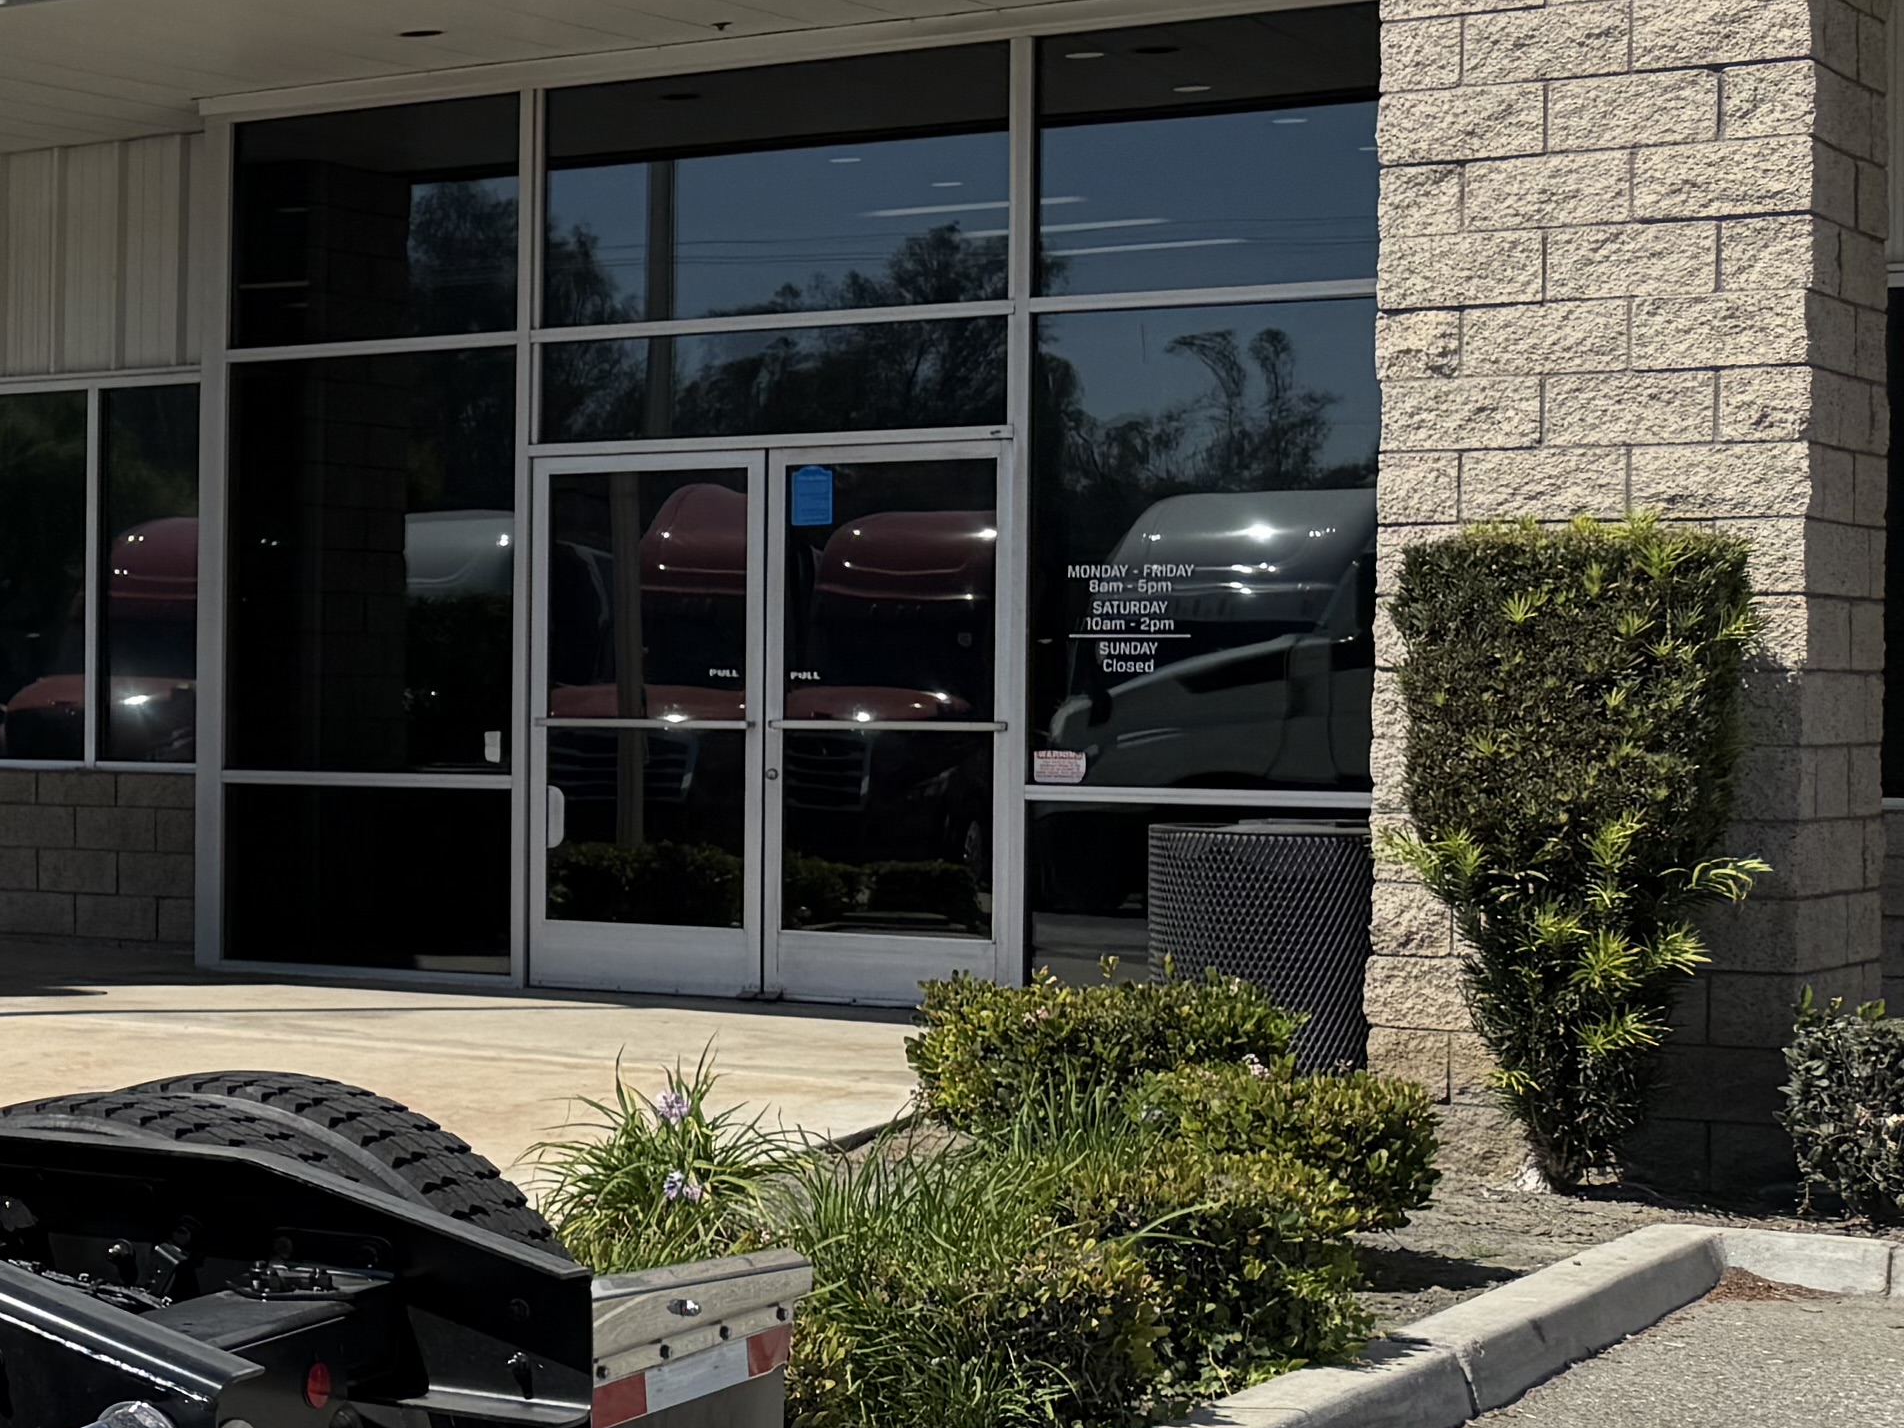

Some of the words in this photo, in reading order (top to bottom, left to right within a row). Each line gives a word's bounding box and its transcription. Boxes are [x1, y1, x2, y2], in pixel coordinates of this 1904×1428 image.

[1067, 565, 1129, 578] MONDAY
[1143, 564, 1195, 578] FRIDAY
[1089, 580, 1123, 593] 8am
[1137, 580, 1172, 594] 5pm
[1092, 601, 1168, 615] SATURDAY
[1086, 617, 1124, 631] 10am
[1140, 618, 1174, 632] 2pm
[1099, 641, 1158, 655] SUNDAY
[709, 668, 740, 677] PULL
[1103, 659, 1154, 673] Closed
[790, 671, 821, 680] PULL
